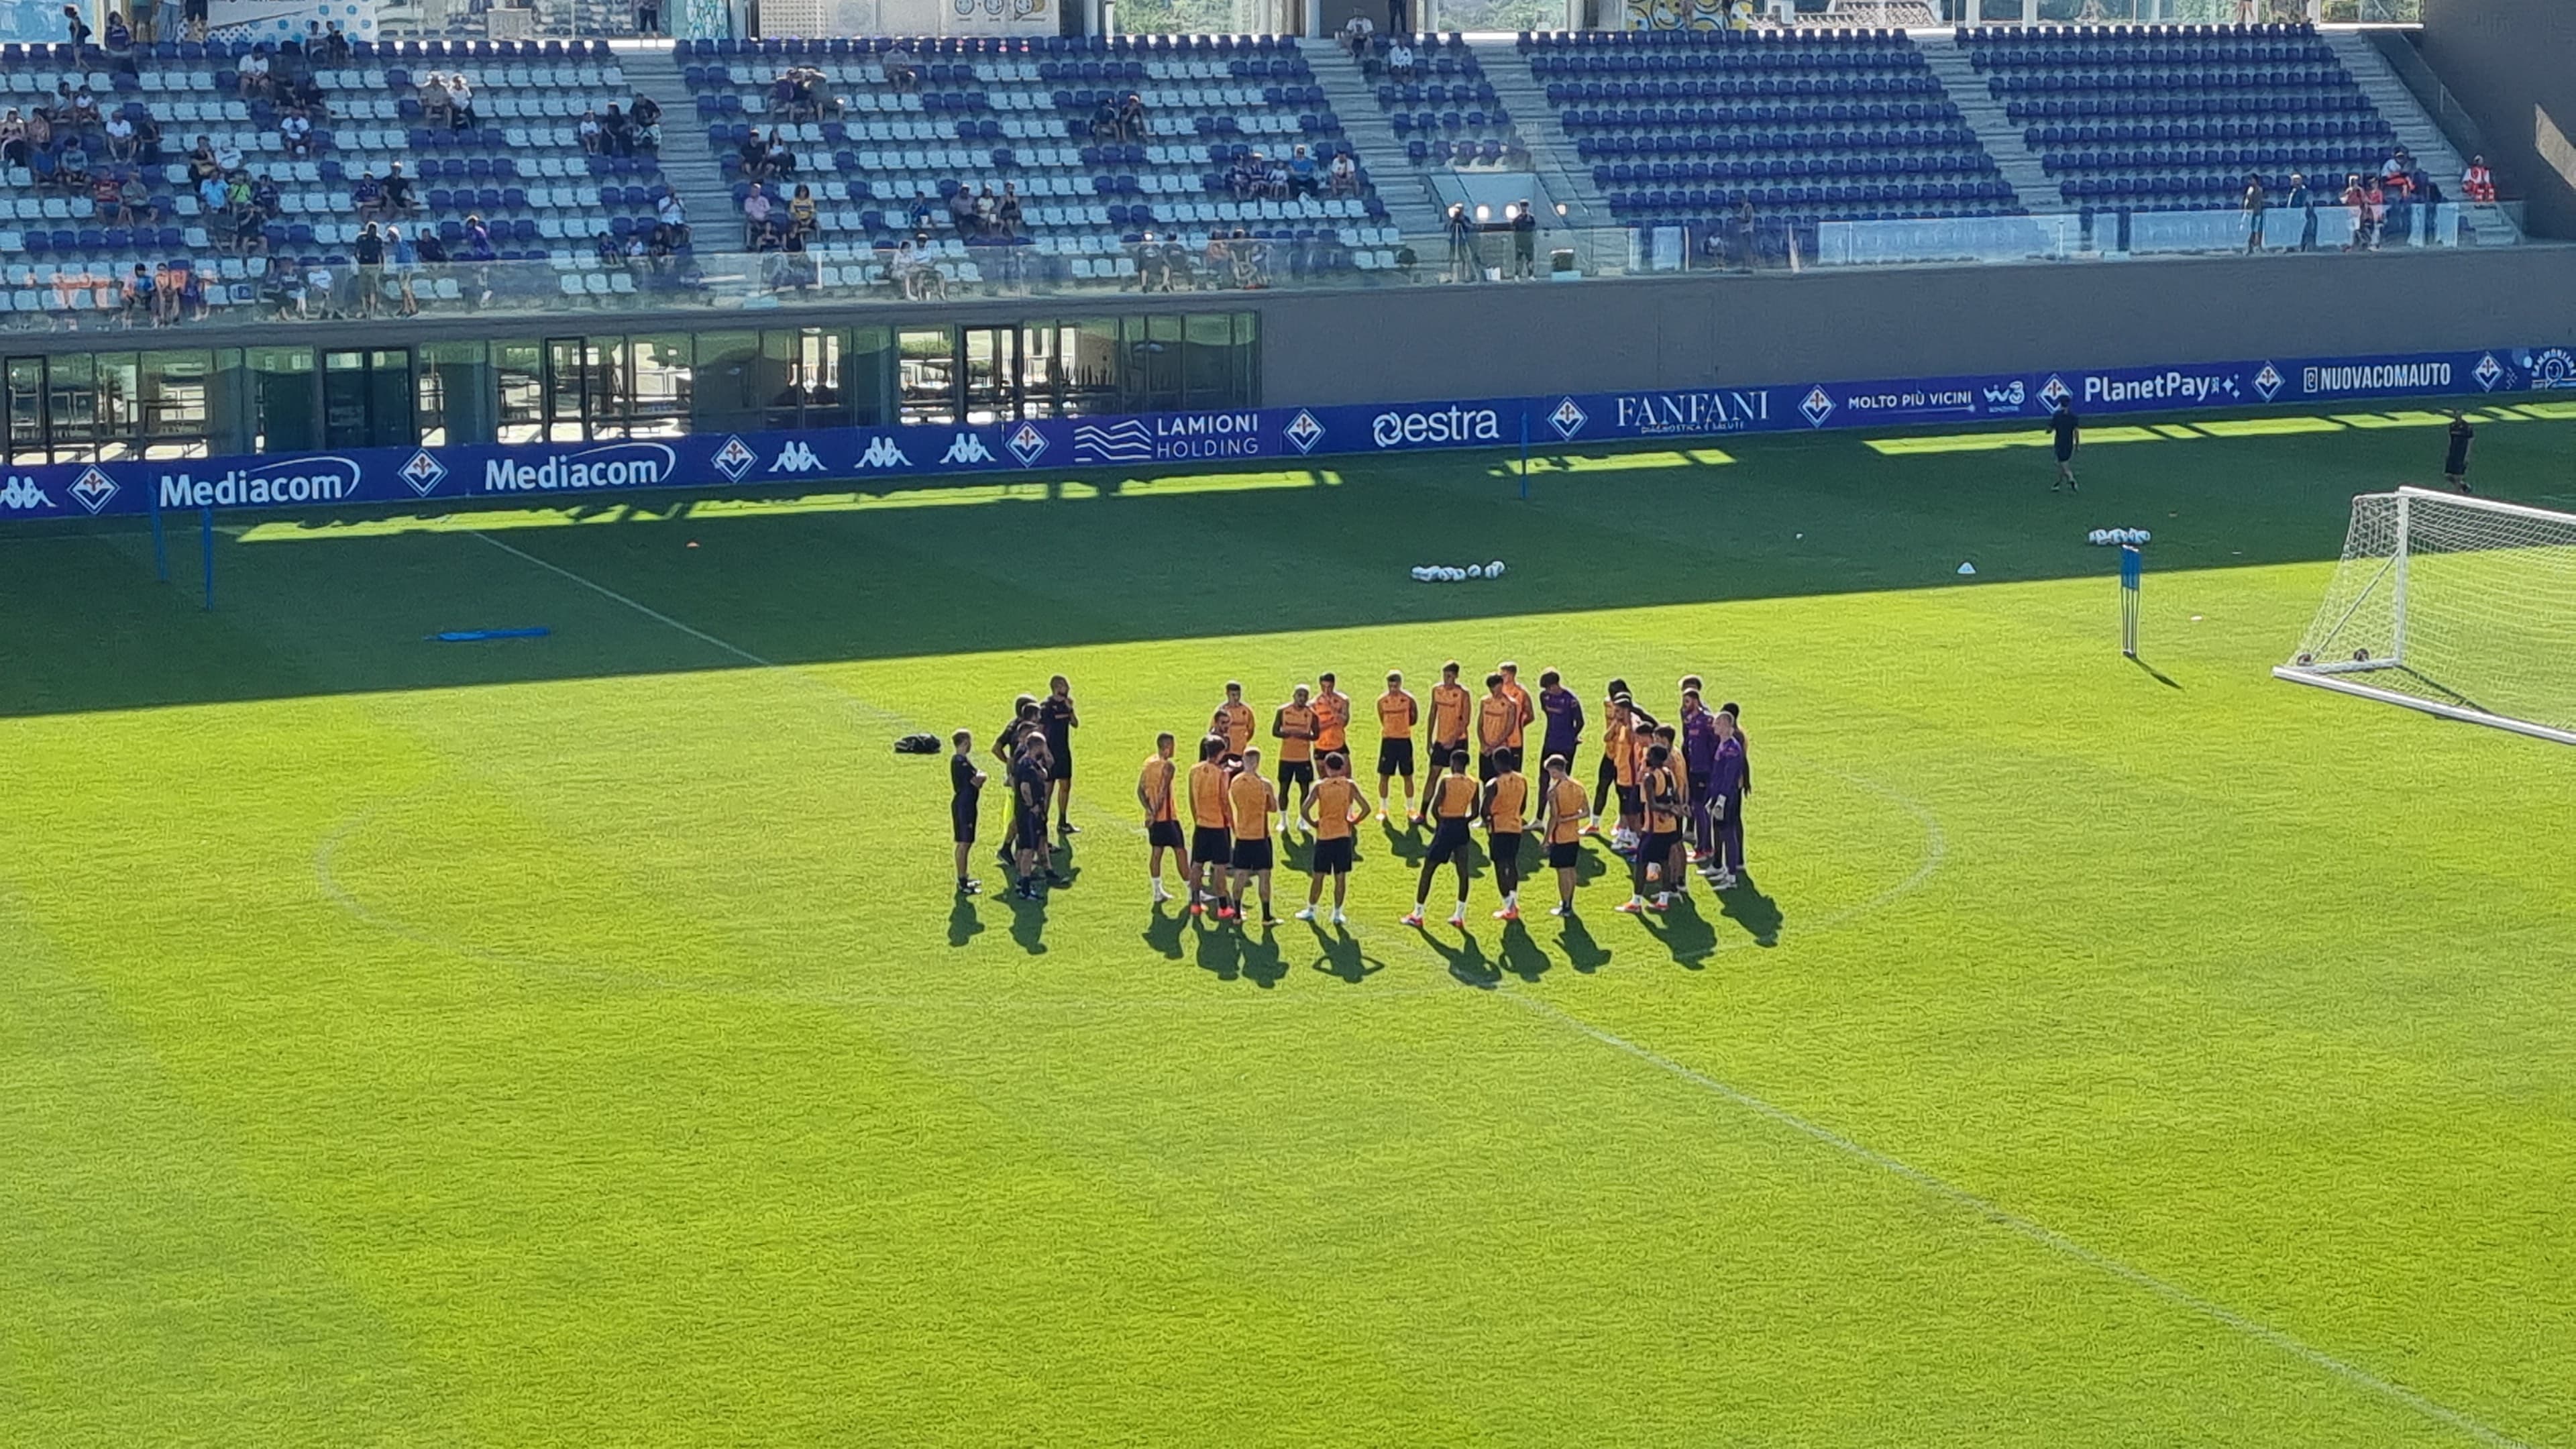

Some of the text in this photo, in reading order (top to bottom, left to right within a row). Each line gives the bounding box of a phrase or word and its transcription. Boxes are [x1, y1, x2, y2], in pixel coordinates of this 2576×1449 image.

[2320, 363, 2451, 390] NUOVACOMAUTO
[1615, 390, 1770, 427] FANFANI
[1848, 390, 1972, 410] MOLTO PIÙ VICINI
[1157, 413, 1258, 436] LAMIONI
[1404, 405, 1500, 443] estra
[1157, 437, 1259, 459] HOLDING
[160, 468, 343, 507] Mediacom
[484, 454, 659, 490] Mediacom
